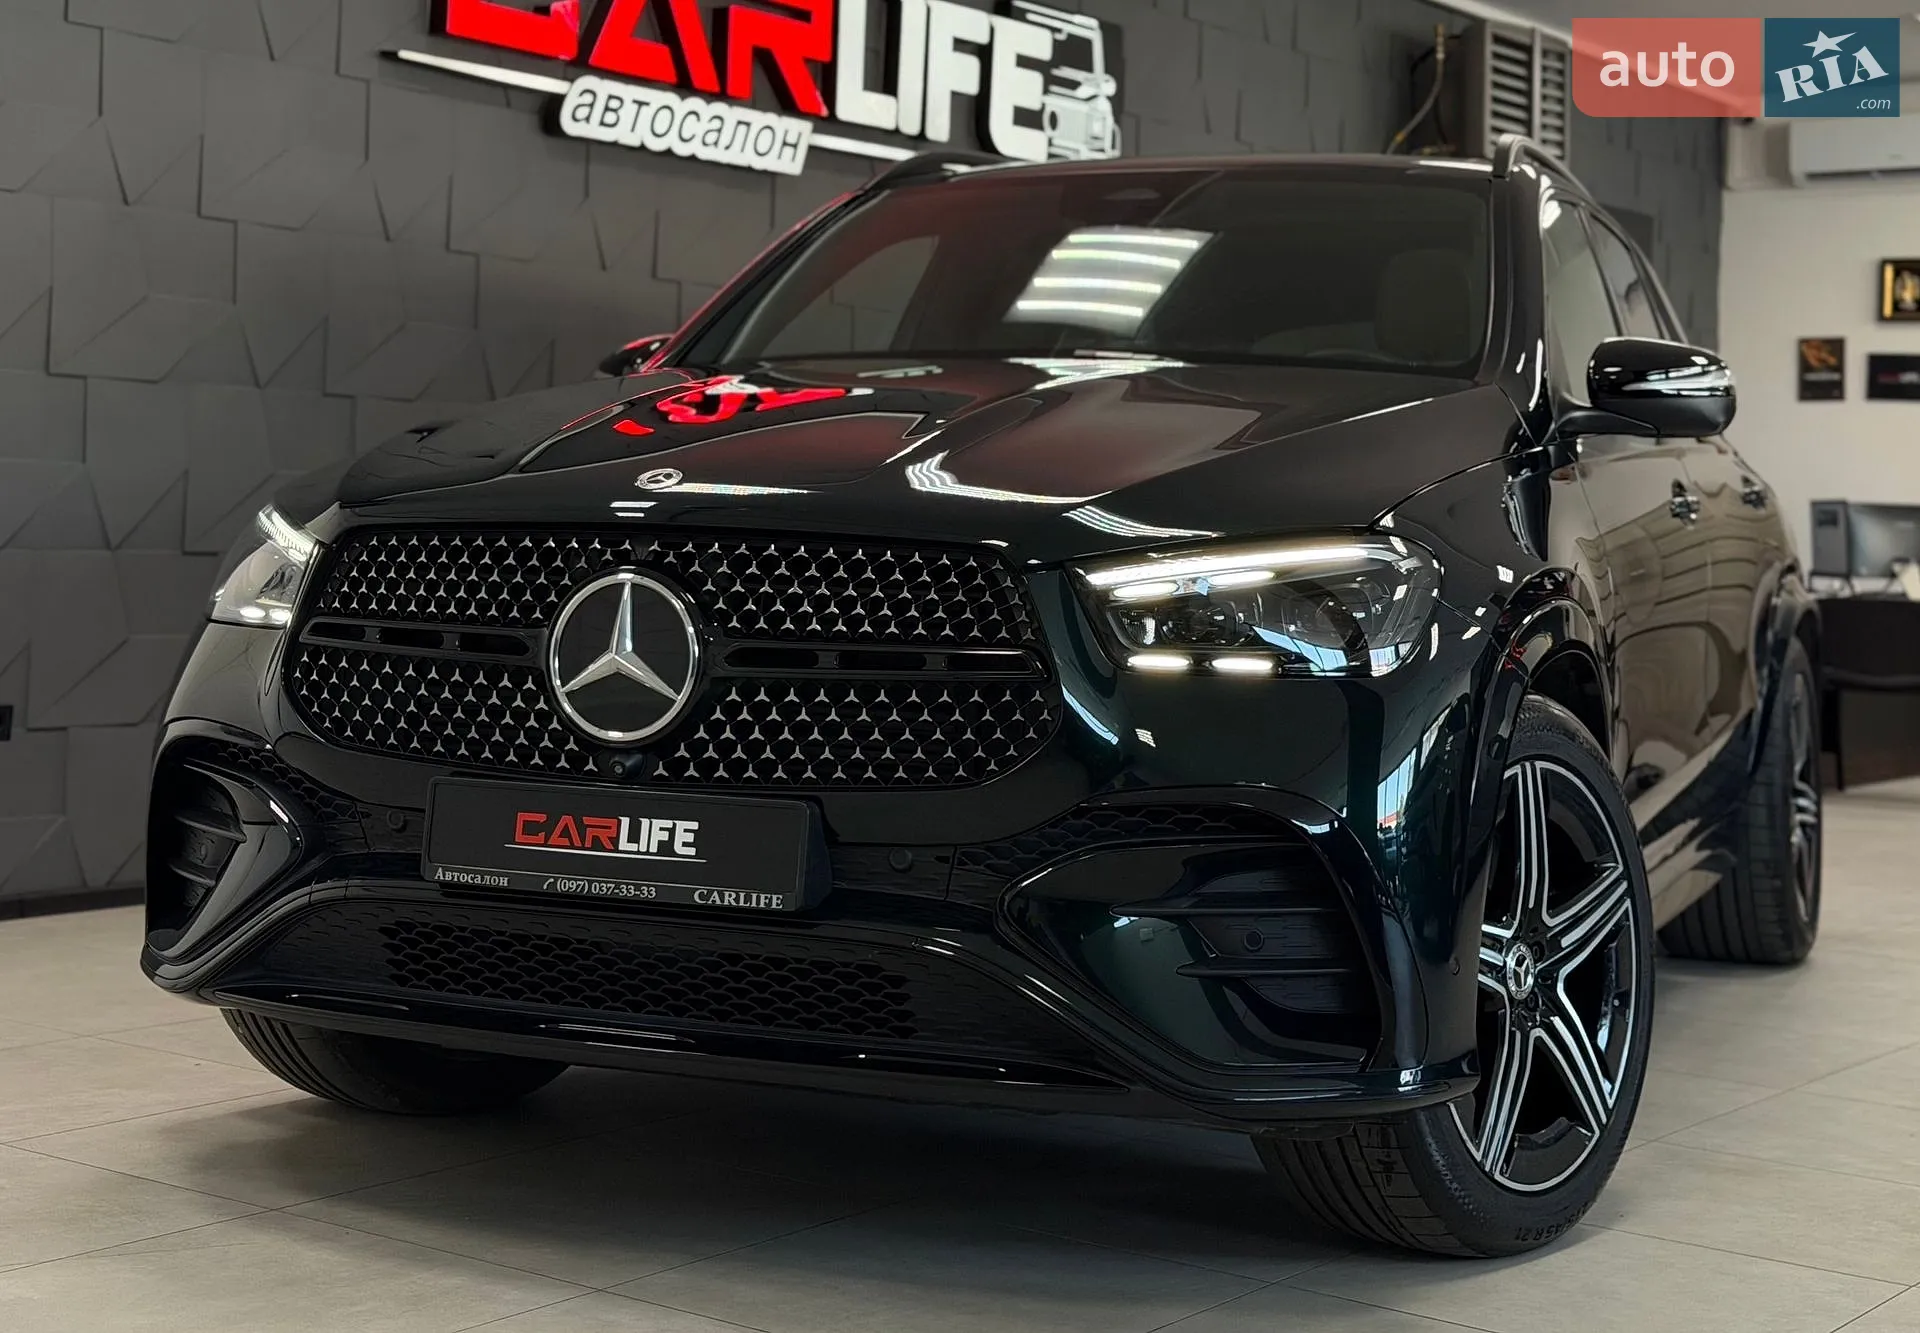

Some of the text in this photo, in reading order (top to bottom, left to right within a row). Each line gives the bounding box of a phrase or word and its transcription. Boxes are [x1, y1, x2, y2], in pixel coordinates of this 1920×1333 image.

[571, 88, 802, 163] автосалон
[514, 812, 699, 855] CARLIFE
[434, 868, 509, 887] Автосалон
[556, 878, 657, 899] (097) 037-33-33
[693, 889, 784, 910] CARLIFE
